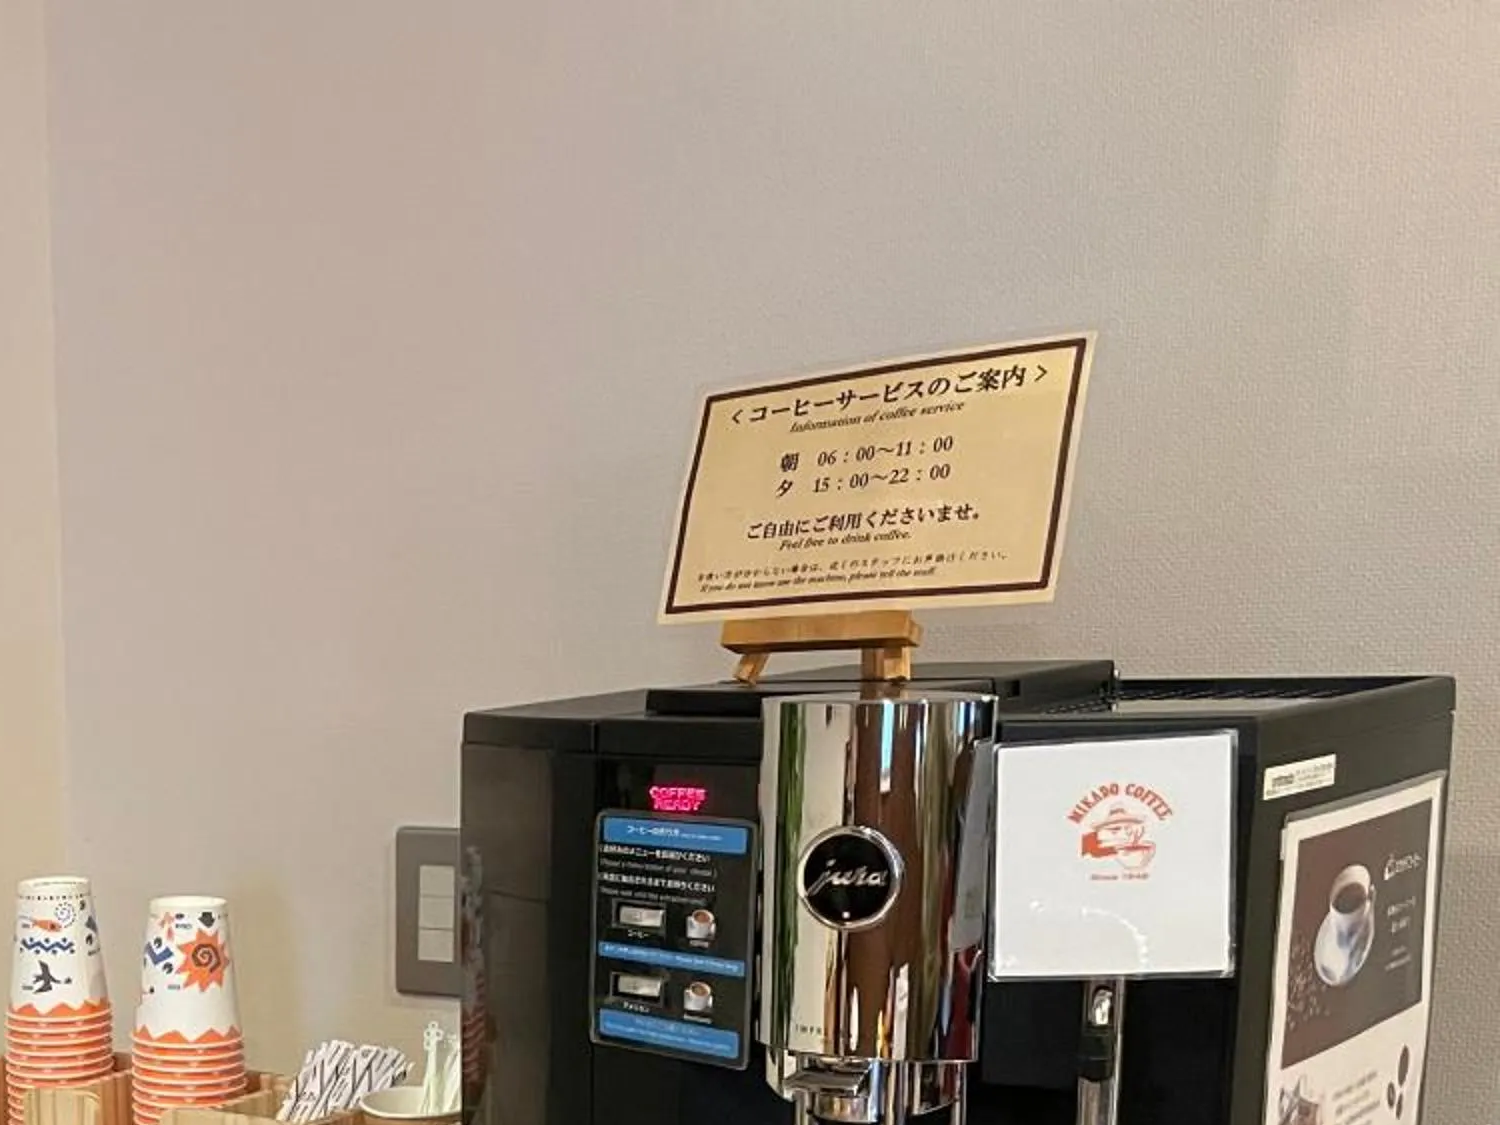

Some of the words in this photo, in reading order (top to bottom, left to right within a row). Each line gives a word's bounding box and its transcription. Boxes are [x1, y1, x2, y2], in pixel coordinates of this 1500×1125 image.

[790, 415, 861, 433] Information
[863, 409, 878, 424] of
[879, 405, 917, 421] coffee
[920, 402, 965, 417] service
[780, 452, 800, 473] 朝
[775, 479, 793, 498] 夕
[779, 538, 802, 550] Feel
[802, 537, 825, 550] free
[827, 535, 839, 545] to
[841, 532, 871, 545] drink
[649, 786, 707, 801] COFFEE
[653, 799, 702, 812] READY
[1067, 783, 1120, 824] MIKADO
[1125, 783, 1173, 821] COFFEE
